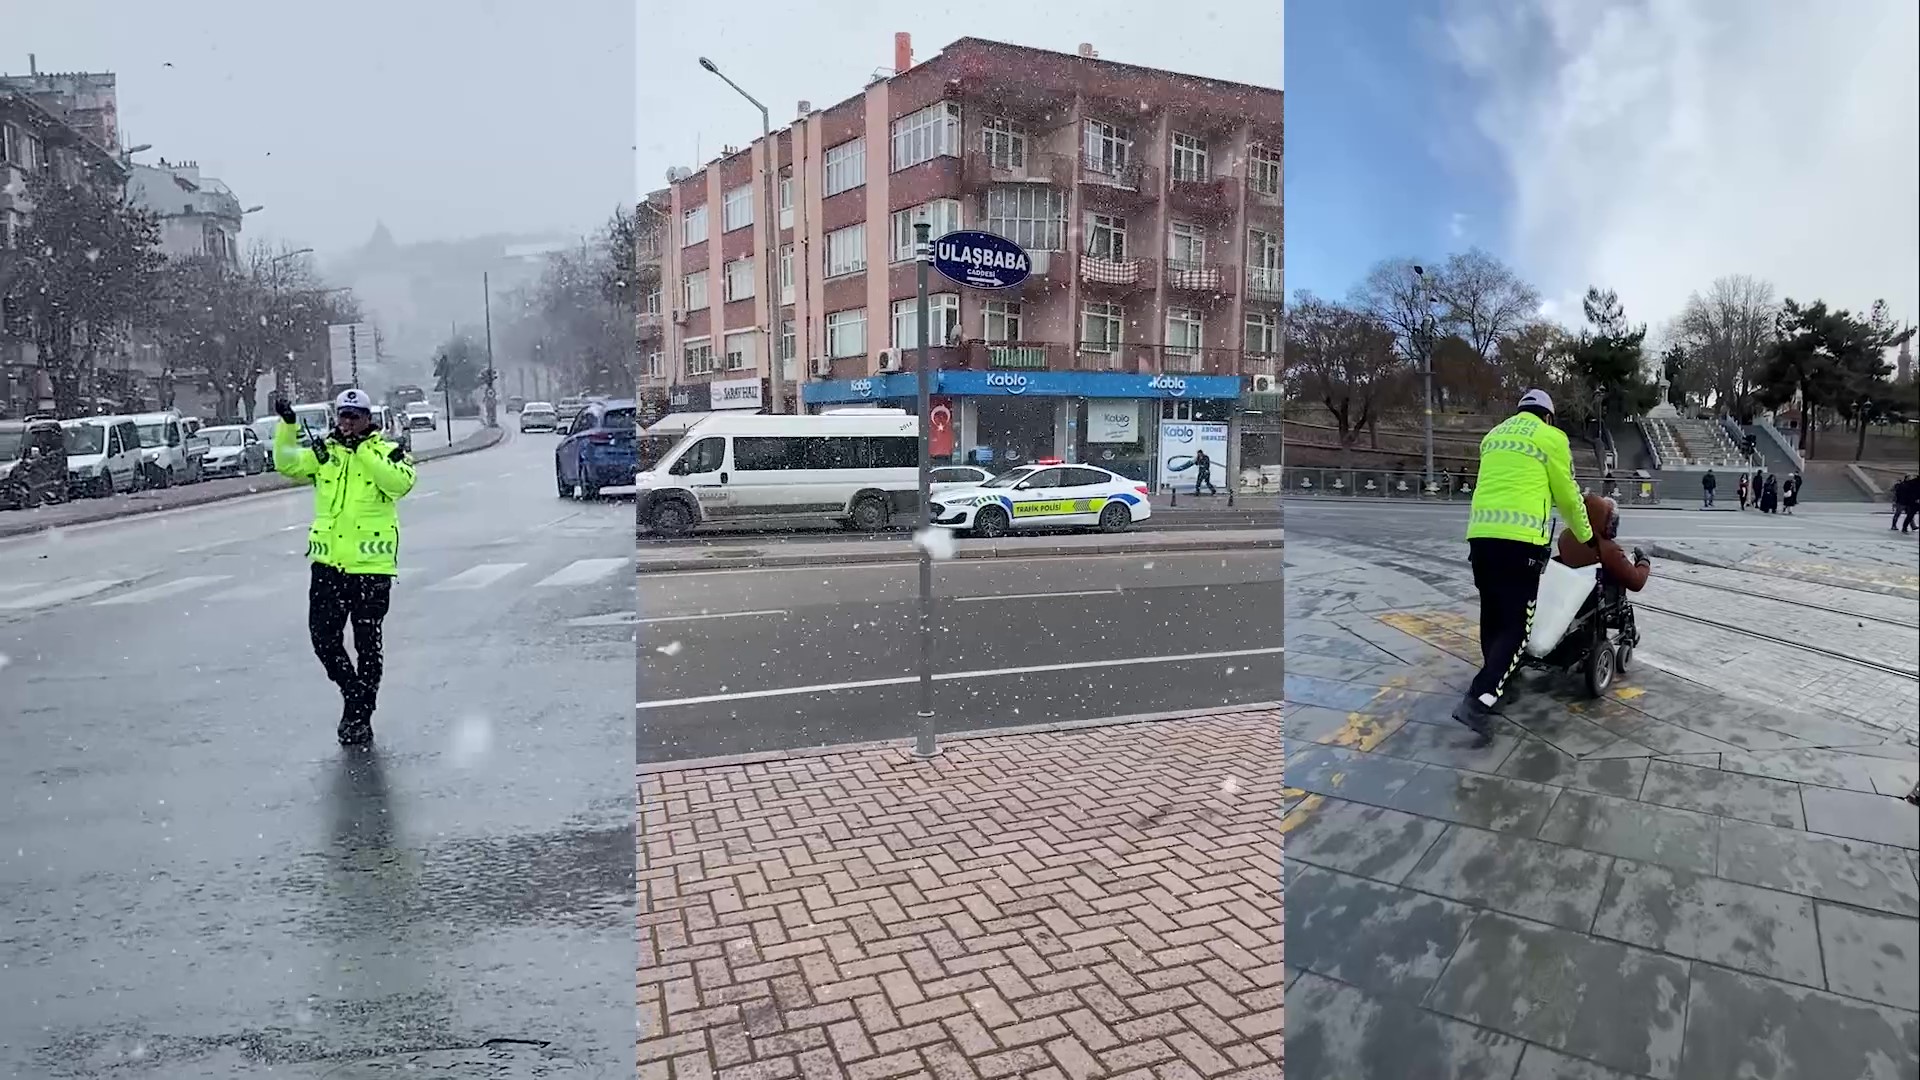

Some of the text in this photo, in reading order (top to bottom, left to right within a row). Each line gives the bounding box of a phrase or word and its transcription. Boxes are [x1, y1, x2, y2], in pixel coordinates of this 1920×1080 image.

[938, 242, 1027, 271] ULAŞBABA
[966, 268, 996, 278] CADDESİ
[986, 373, 1027, 386] Kablo
[1152, 376, 1186, 389] Kablo
[1104, 413, 1130, 423] Kablo
[1163, 426, 1194, 438] Kablo
[1016, 503, 1062, 513] TRAFİK POLİSİ
